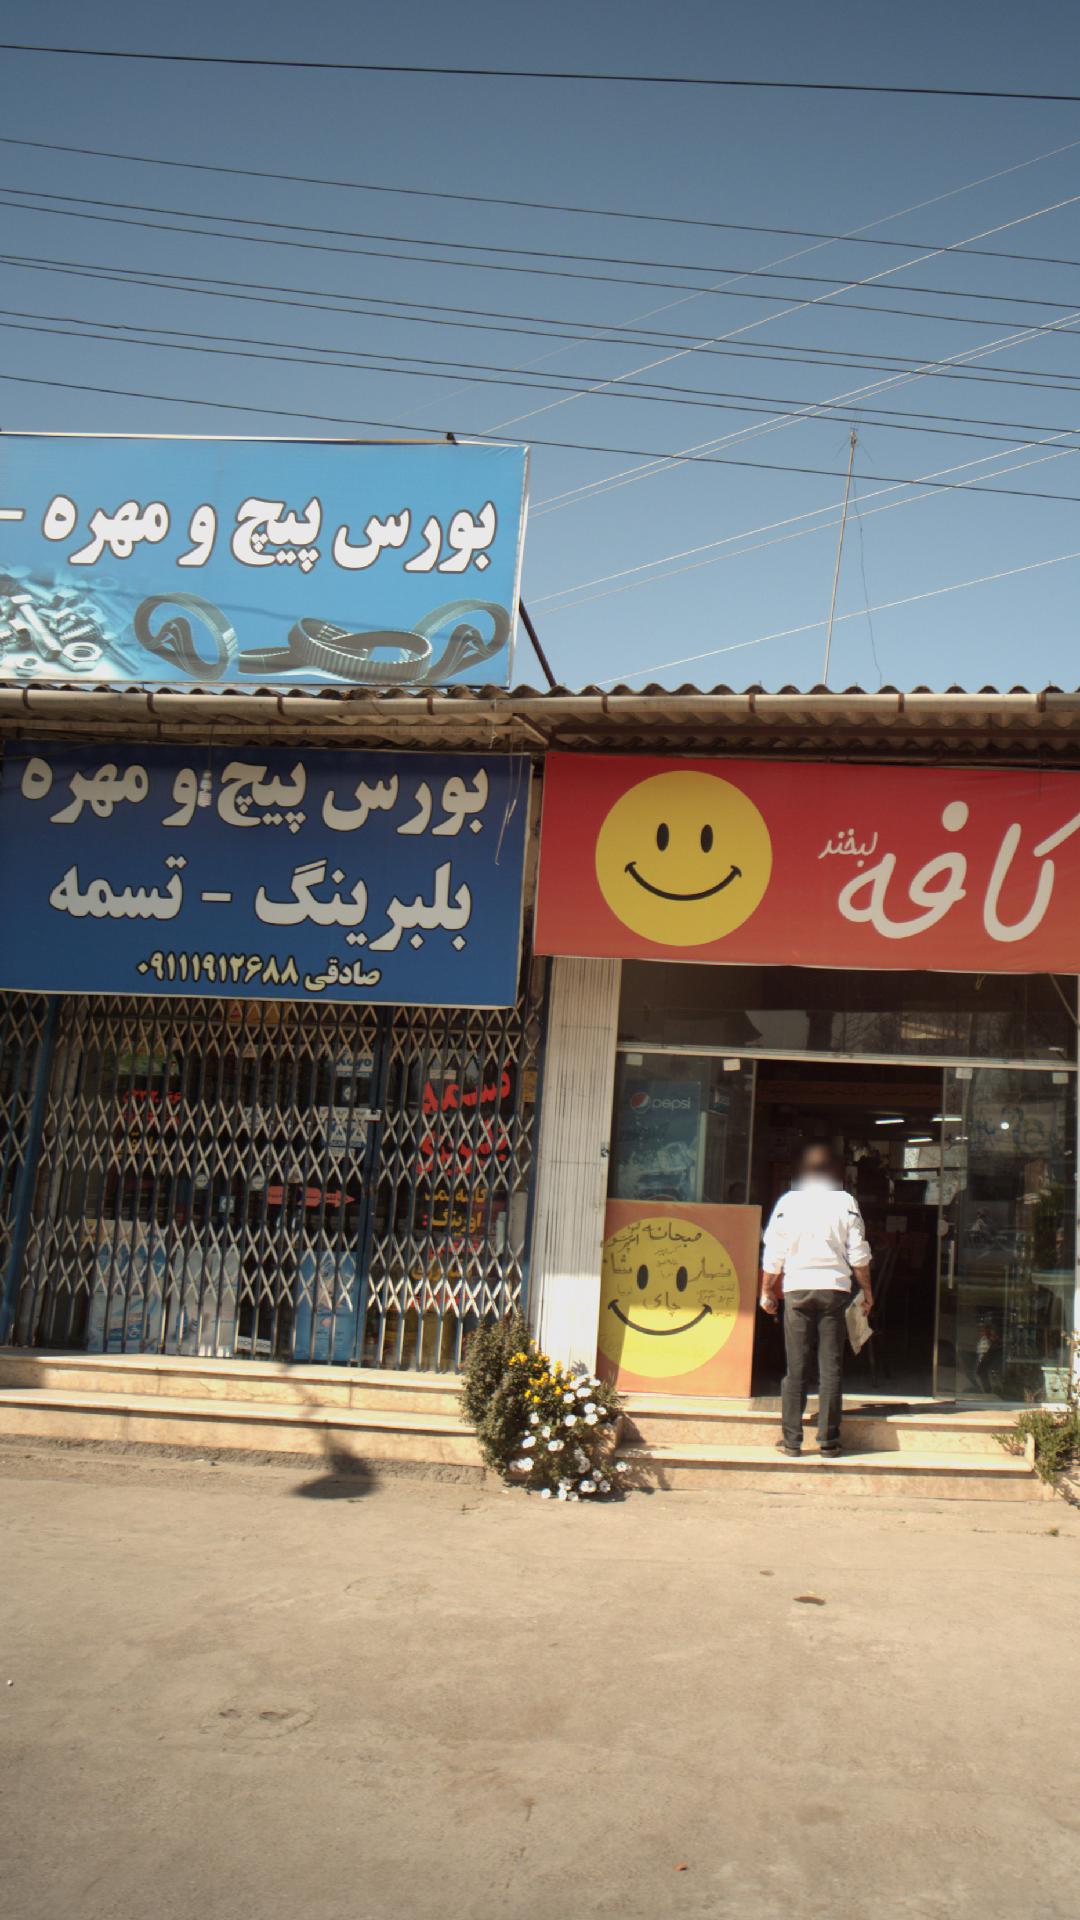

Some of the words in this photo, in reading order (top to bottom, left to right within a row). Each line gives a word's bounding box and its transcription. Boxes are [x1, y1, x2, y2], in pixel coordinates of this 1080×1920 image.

[43, 495, 169, 565] مهره
[177, 504, 216, 567] و
[231, 496, 321, 573] پیچ
[332, 500, 496, 573] بورس
[20, 757, 149, 823] مهره
[162, 768, 198, 826] و
[217, 761, 306, 833] پیچ
[322, 768, 489, 836] بورس
[818, 828, 878, 867] لبخند
[838, 801, 1080, 942] کافه
[49, 855, 184, 920] تسمه
[255, 859, 471, 951] بلبرینگ
[304, 957, 381, 991] صادقی
[652, 1097, 691, 1111] pepsi
[642, 1222, 702, 1248] صبحانه
